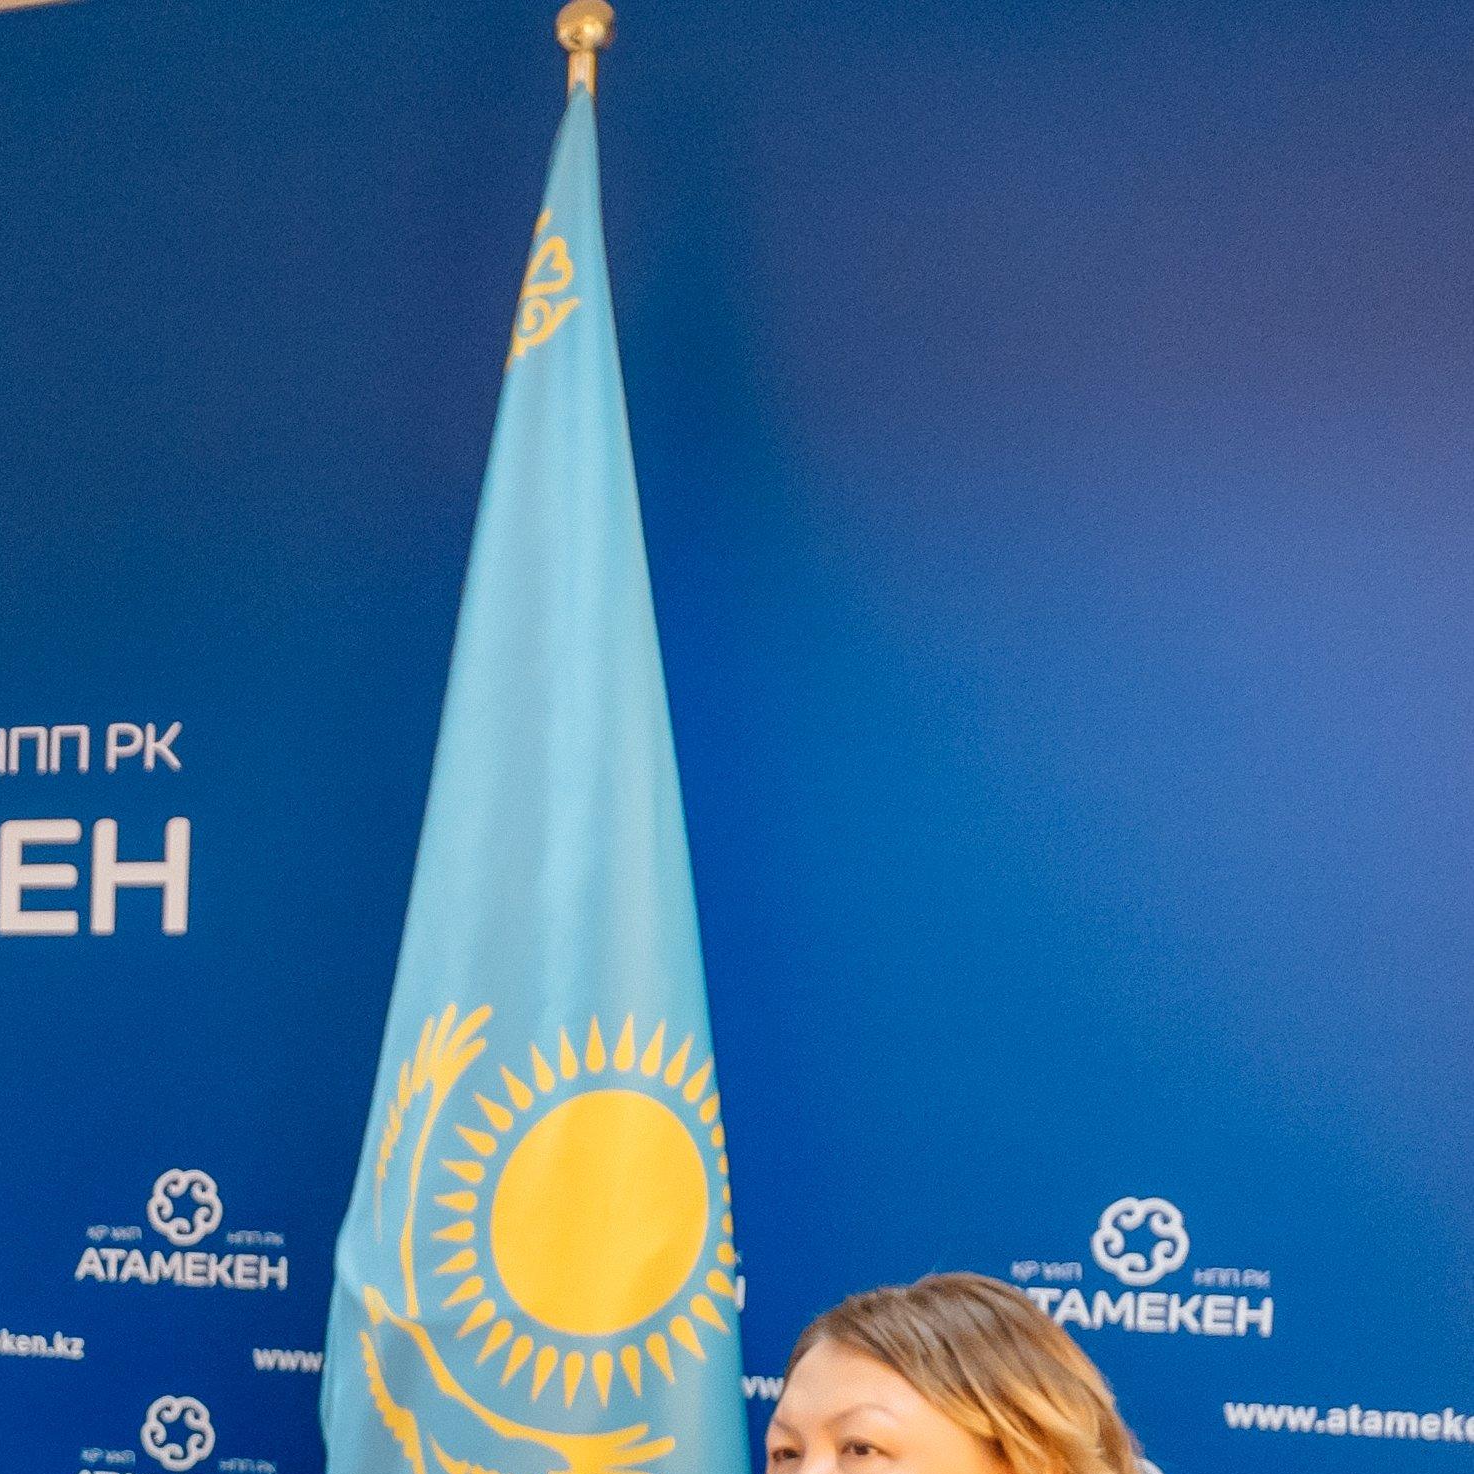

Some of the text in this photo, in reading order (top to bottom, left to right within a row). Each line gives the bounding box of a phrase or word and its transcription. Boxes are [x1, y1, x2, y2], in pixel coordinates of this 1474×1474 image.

[105, 720, 183, 774] РК
[74, 1247, 288, 1290] АТАМЕКЕН
[1023, 1286, 1273, 1338] ТАМЕКЕН
